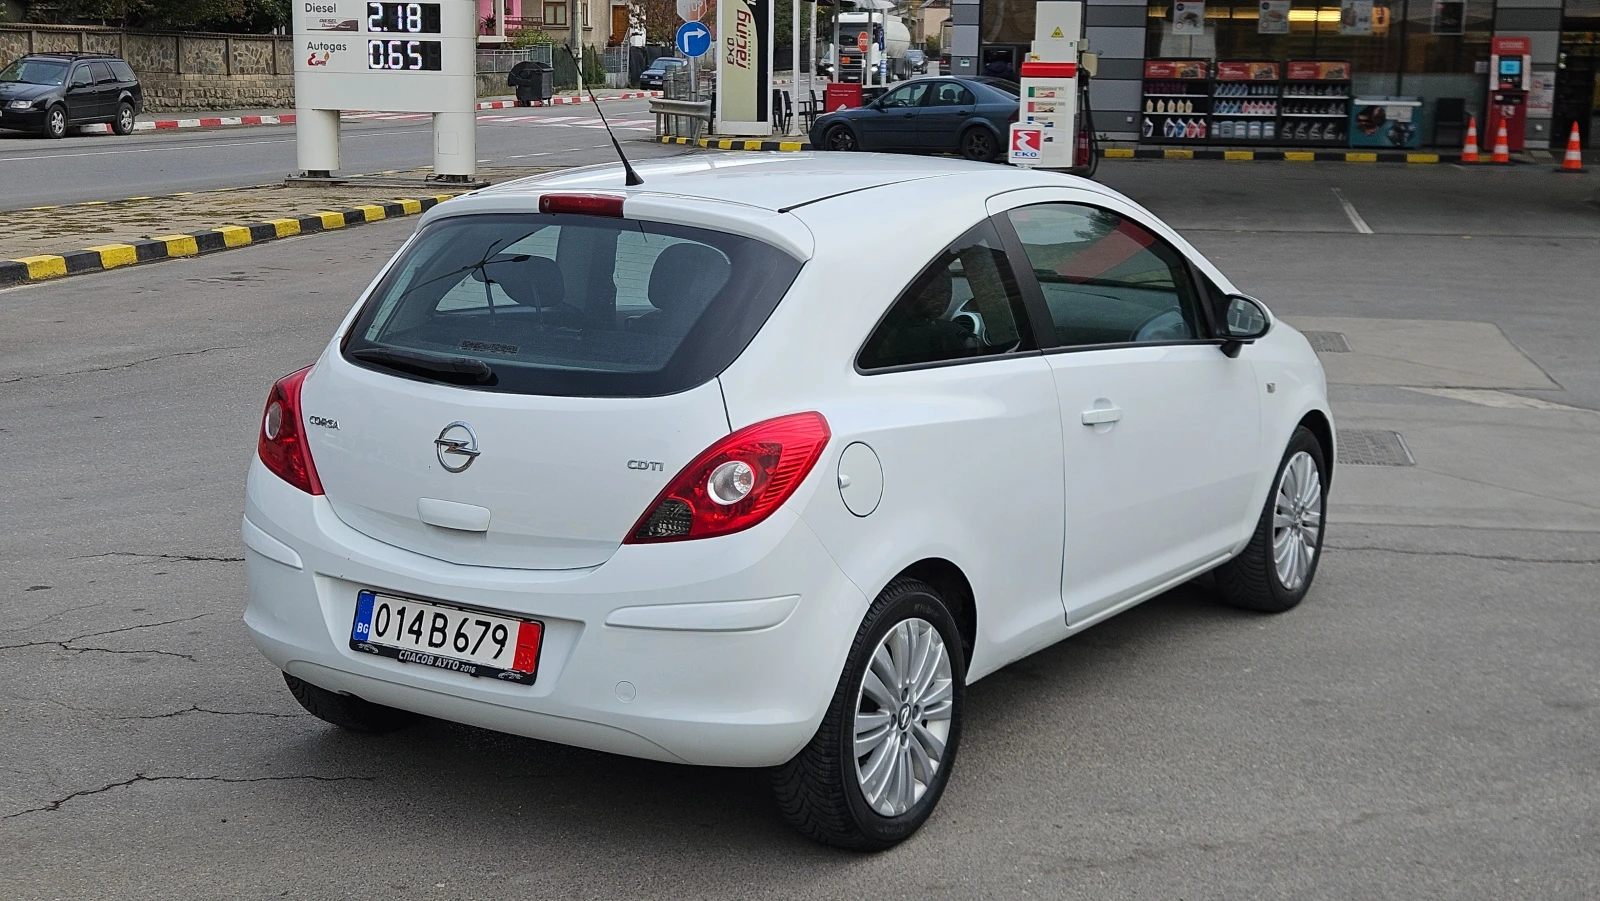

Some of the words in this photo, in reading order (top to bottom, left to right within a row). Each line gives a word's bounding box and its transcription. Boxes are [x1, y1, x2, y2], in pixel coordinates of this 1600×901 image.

[304, 2, 337, 13] Diesel
[368, 2, 421, 32] 2.18
[735, 9, 752, 69] racing
[306, 41, 347, 53] Autogas
[368, 40, 423, 70] 0.65
[309, 415, 341, 431] CORSA
[356, 622, 369, 634] BG
[374, 602, 509, 660] 014B679
[398, 650, 435, 665] СПАСОВ
[435, 658, 460, 670] АУТО
[460, 664, 477, 674] 2016
